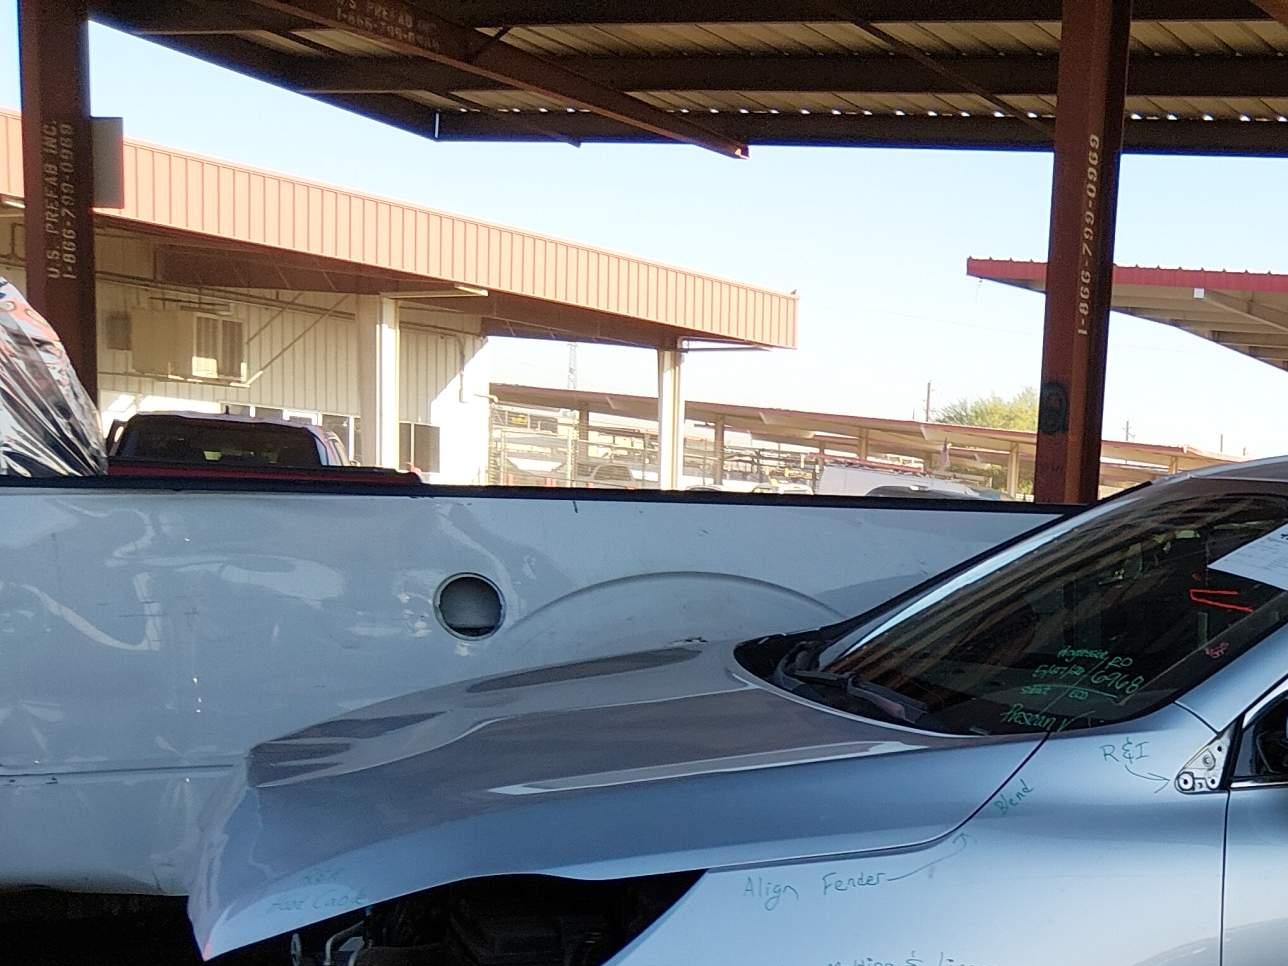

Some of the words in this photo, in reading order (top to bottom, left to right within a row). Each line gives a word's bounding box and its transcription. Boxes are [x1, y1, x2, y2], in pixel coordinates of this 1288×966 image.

[42, 120, 58, 154] INC.
[44, 163, 59, 234] PREFAB
[1078, 133, 1100, 335] 1-866-799-0969
[47, 246, 61, 279] U.S.
[743, 876, 800, 911] Align
[822, 872, 886, 896] Fender
